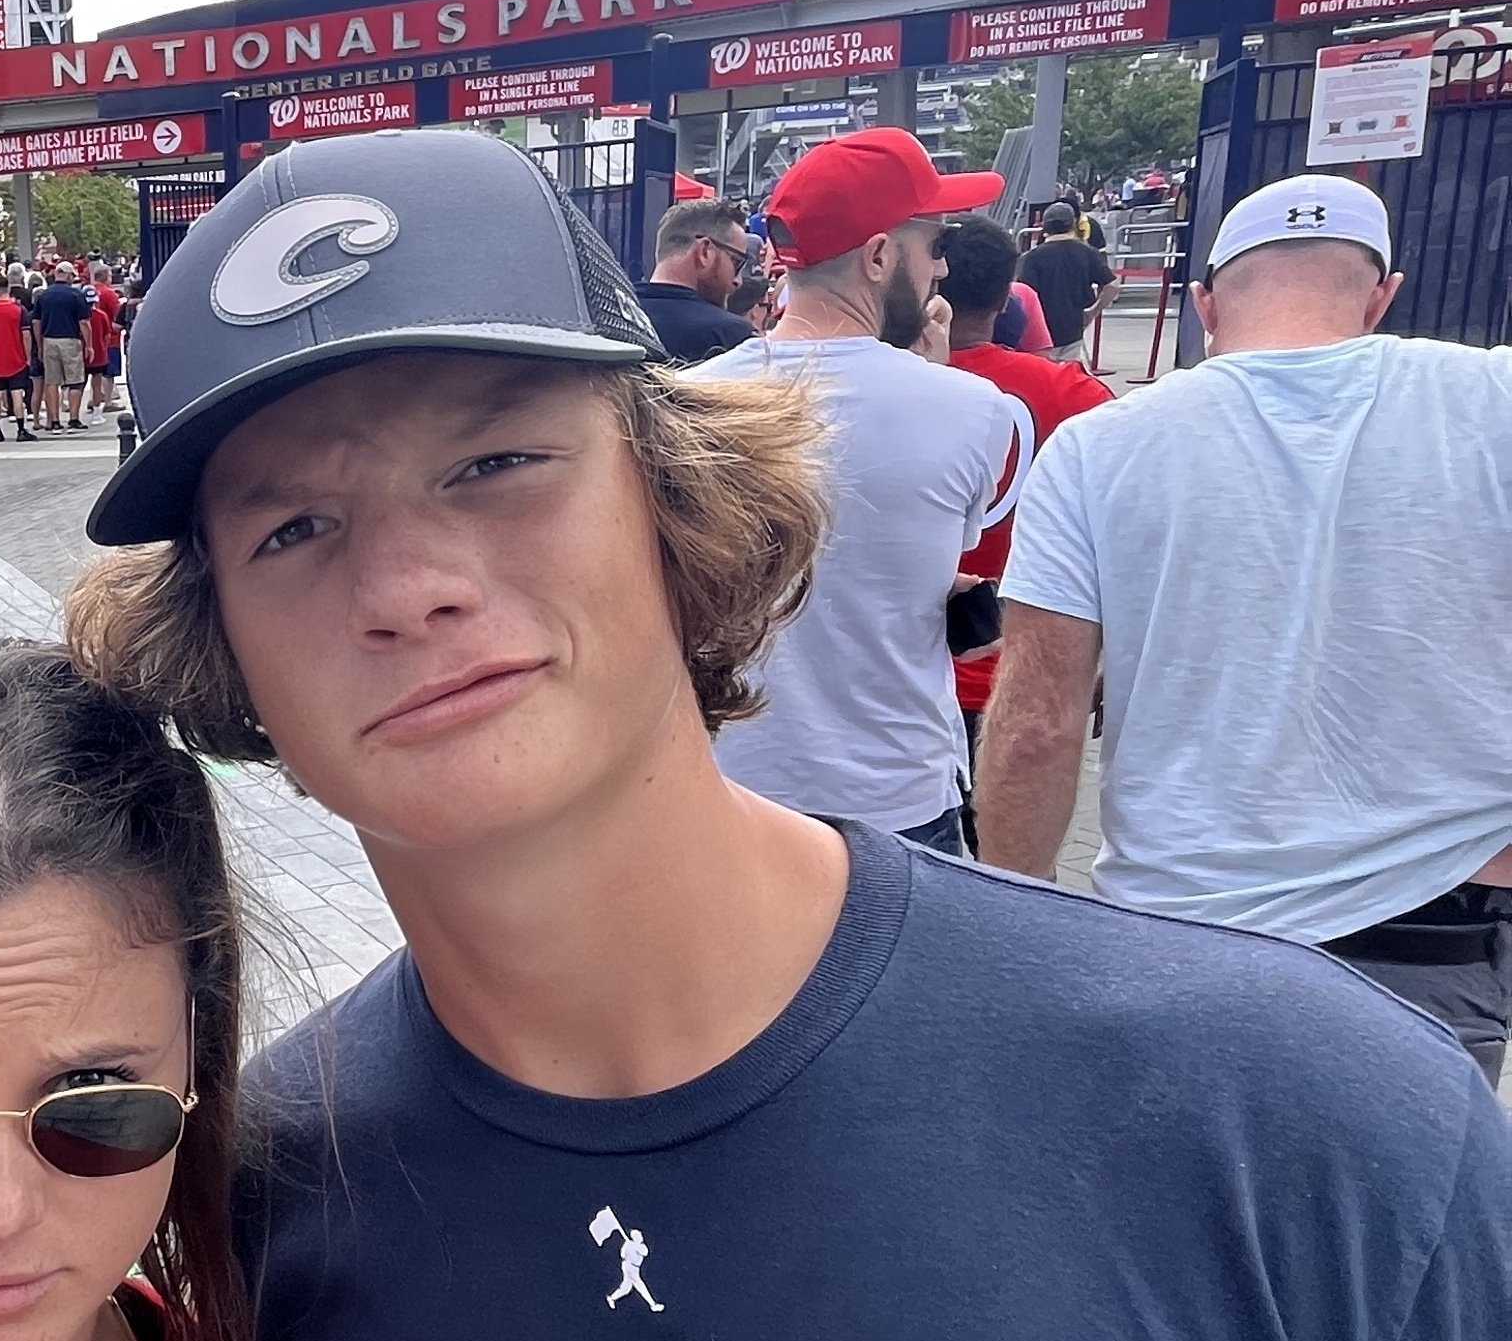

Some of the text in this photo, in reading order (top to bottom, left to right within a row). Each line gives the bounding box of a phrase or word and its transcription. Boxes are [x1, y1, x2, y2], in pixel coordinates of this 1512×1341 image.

[972, 13, 1016, 28] PLEASE
[1019, 2, 1082, 22] CONTINUE
[1300, 2, 1317, 16] DO
[989, 13, 1125, 41] IN A SINGLE FILE LINE
[52, 3, 466, 88] NATIONALS
[755, 35, 836, 59] WELCOME
[841, 31, 862, 48] TO
[970, 28, 1144, 58] DO NOT REMOVE PERSONAL ITEMS
[755, 45, 894, 76] NATIONALS PARK
[234, 55, 492, 100] CENTER FIELD GATE
[465, 65, 595, 91] PLEASE CONTINUE THROUGH
[302, 94, 365, 114] WELCOME
[369, 92, 385, 109] TO
[479, 80, 580, 102] IN A SINGLE FILE LINE
[303, 105, 410, 129] NATIONALS PARK
[465, 93, 595, 116] DO NOT REMOVE PERSONAL ITEMS
[25, 133, 60, 152] GATES
[63, 132, 77, 148] AT
[79, 128, 106, 146] LEFT
[109, 123, 148, 143] FIELD,
[26, 151, 49, 169] AND
[51, 147, 85, 166] HOME
[88, 143, 123, 162] PLATE
